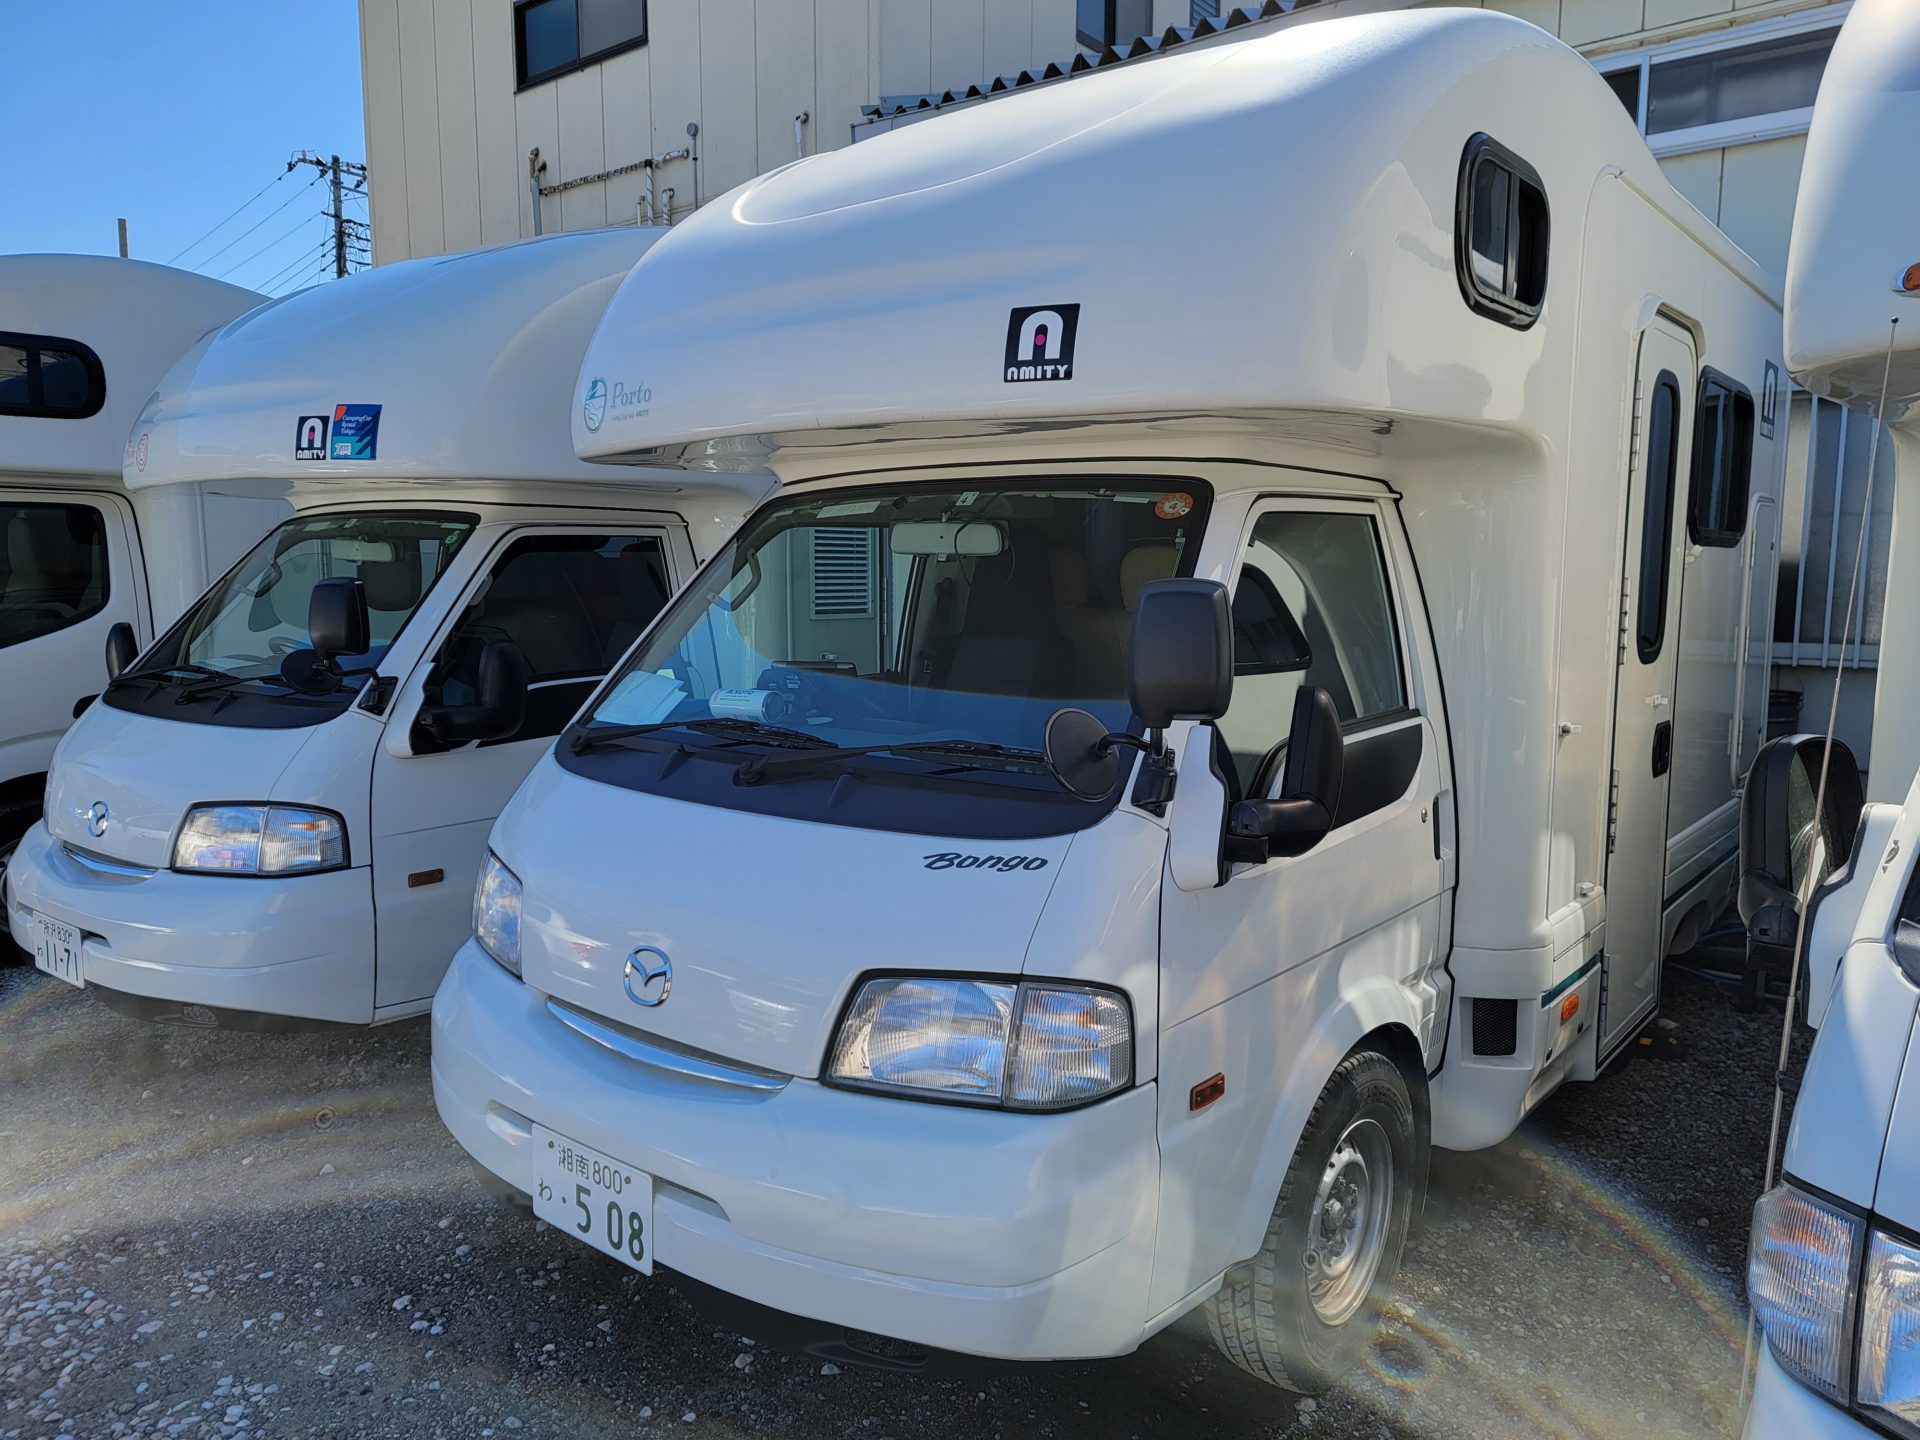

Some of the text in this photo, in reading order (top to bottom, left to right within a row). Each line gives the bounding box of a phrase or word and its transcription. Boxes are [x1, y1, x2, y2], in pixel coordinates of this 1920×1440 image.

[1006, 364, 1069, 381] AMITY
[610, 380, 652, 408] Porto
[296, 449, 325, 460] AMITY
[922, 852, 1049, 873] Bongo
[45, 939, 79, 982] 11-71
[538, 1176, 553, 1202] わ
